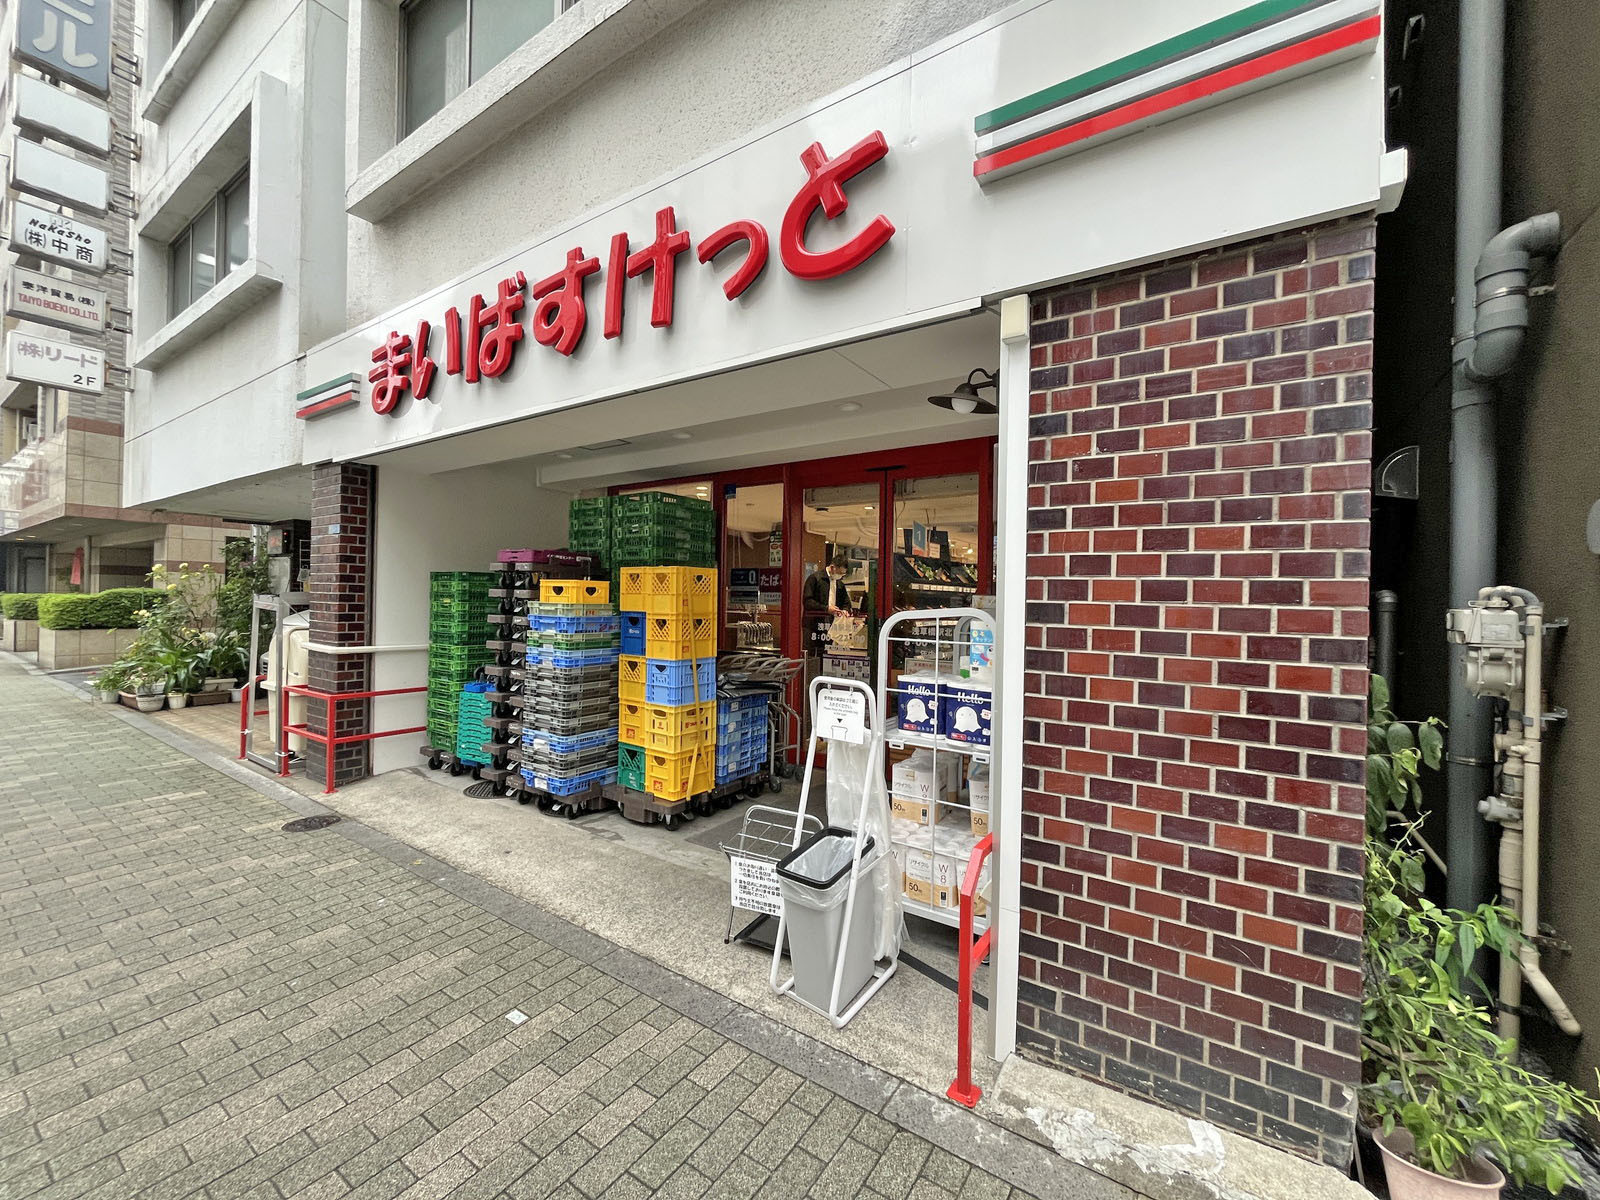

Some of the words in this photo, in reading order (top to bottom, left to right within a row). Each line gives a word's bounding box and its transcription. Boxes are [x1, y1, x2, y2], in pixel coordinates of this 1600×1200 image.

[368, 129, 896, 415] まいばすけっと
[18, 293, 42, 306] TAIYO
[17, 341, 98, 368] (株)リード
